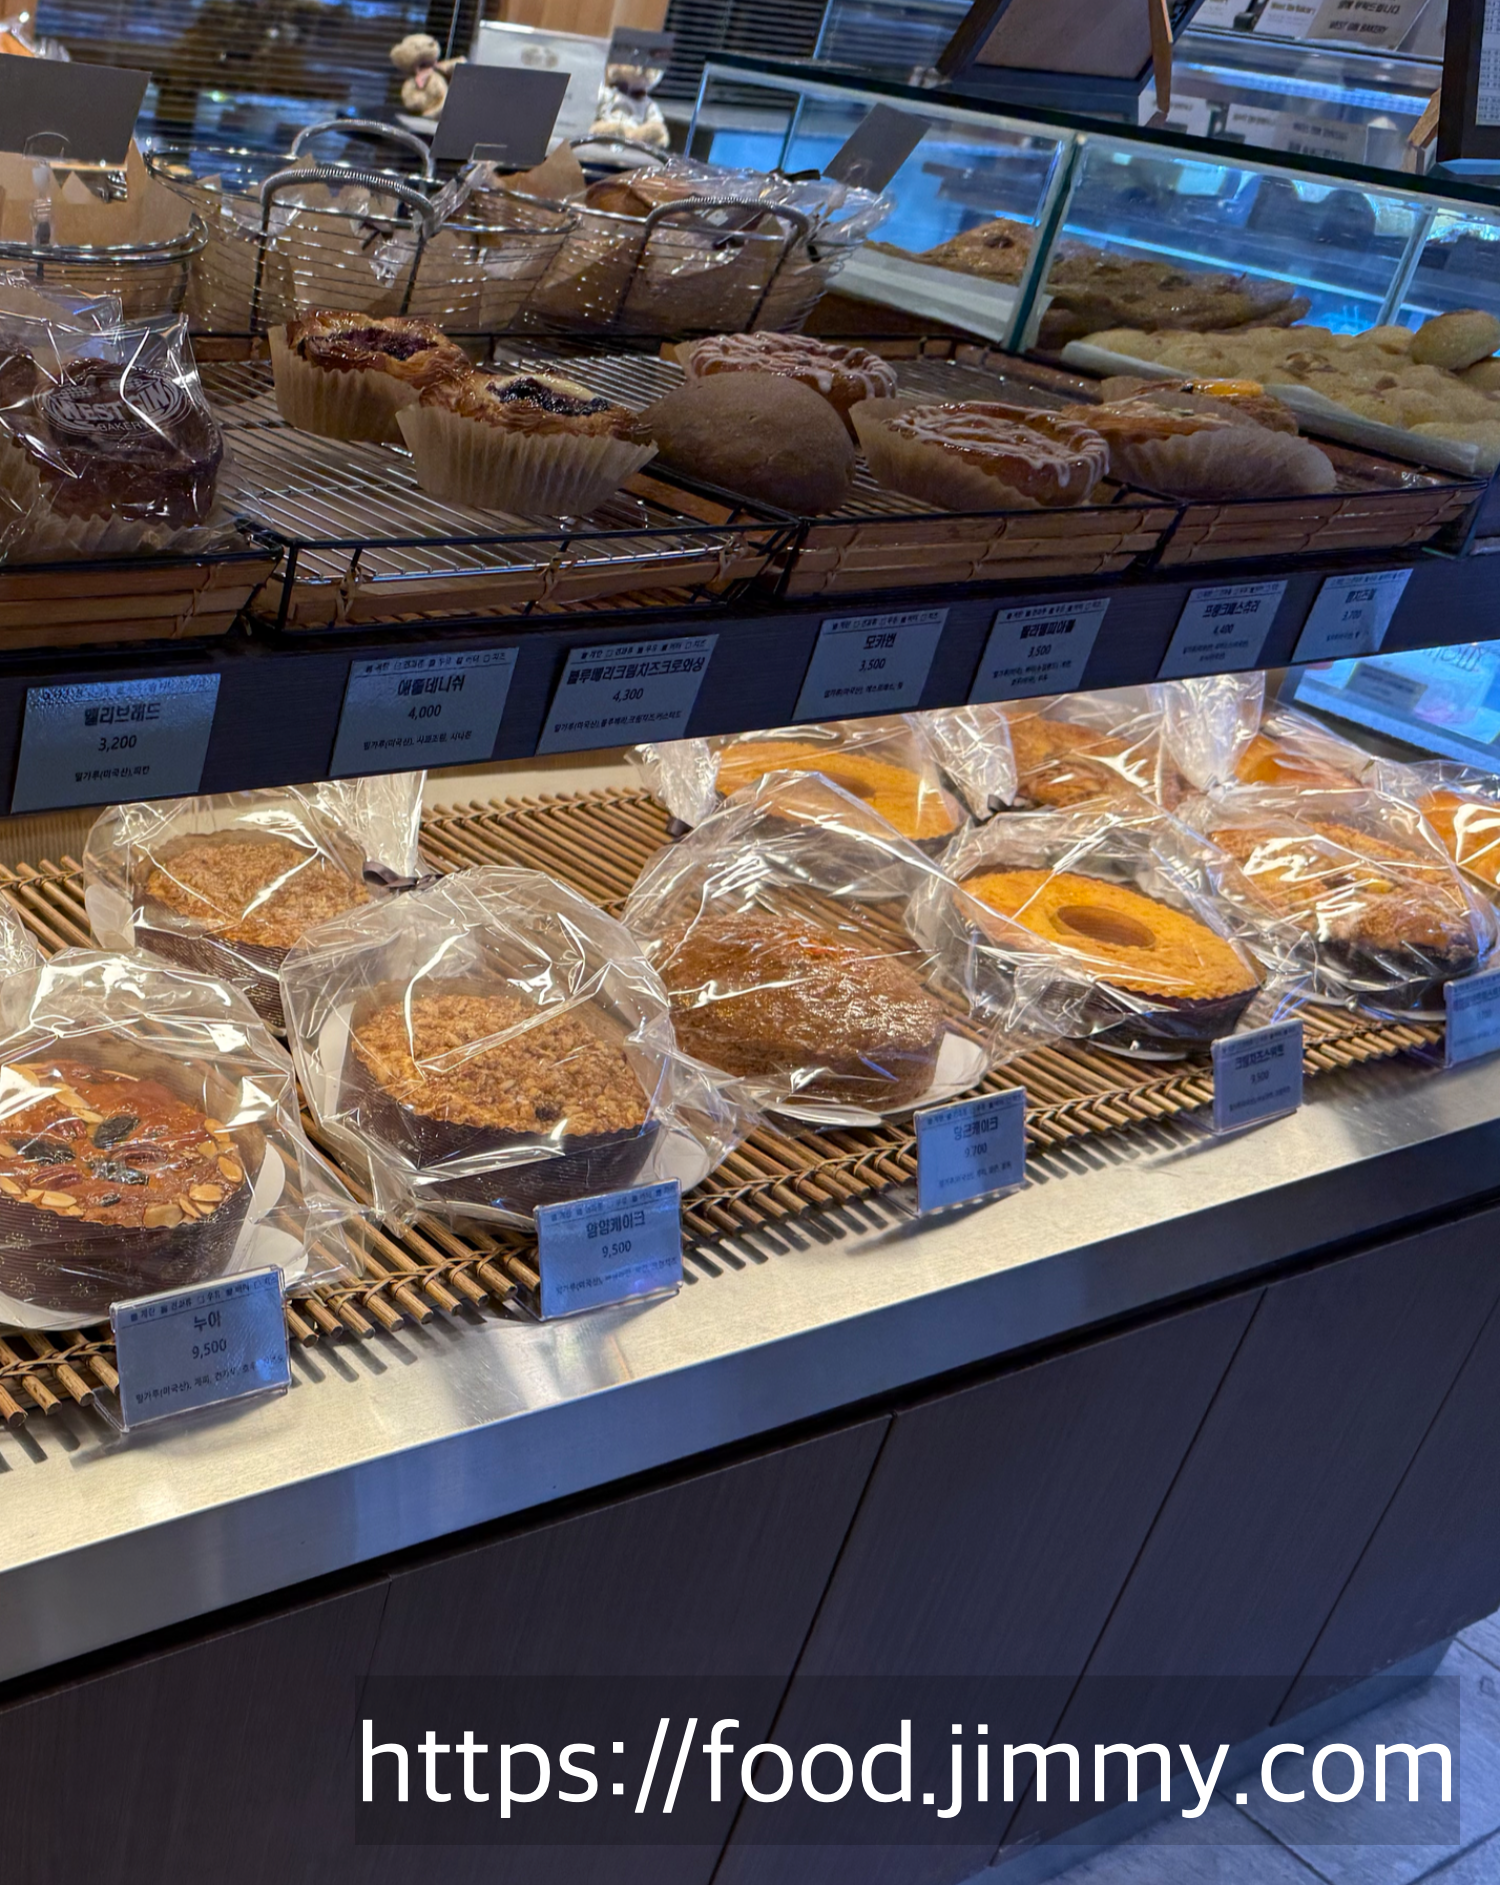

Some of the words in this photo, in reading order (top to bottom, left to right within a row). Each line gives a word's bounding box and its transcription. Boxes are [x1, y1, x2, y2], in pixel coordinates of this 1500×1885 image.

[50, 398, 126, 421] WEST
[863, 633, 897, 650] 모카번
[1028, 644, 1052, 658] 3,500
[859, 658, 886, 672] 3,500
[612, 688, 644, 703] 4,300
[408, 704, 442, 720] 4,000
[98, 734, 138, 753] 3,200
[954, 1116, 998, 1140] 당근케이크
[964, 1142, 987, 1158] 9,700
[602, 1240, 632, 1259] 9,500
[191, 1338, 227, 1360] 9,500
